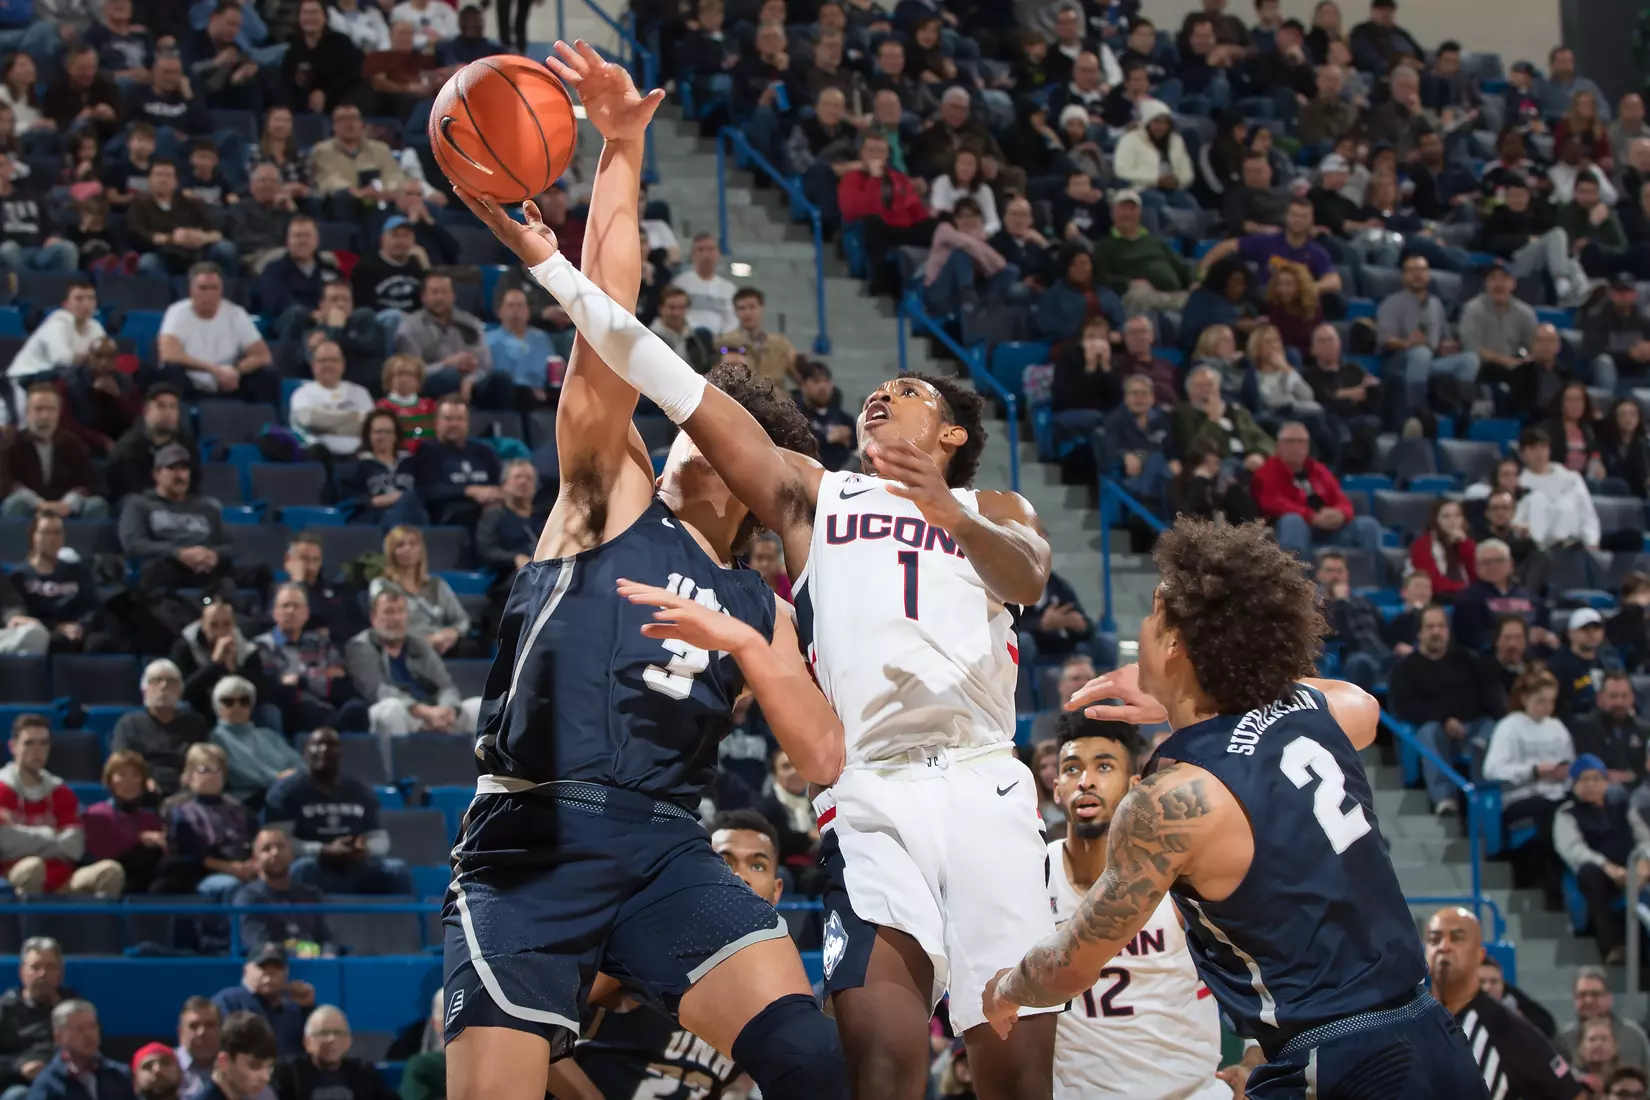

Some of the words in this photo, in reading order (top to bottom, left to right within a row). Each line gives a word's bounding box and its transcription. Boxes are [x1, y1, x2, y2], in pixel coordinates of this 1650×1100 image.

[826, 513, 966, 560] UCON
[898, 551, 919, 621] 1
[1279, 735, 1373, 855] 2
